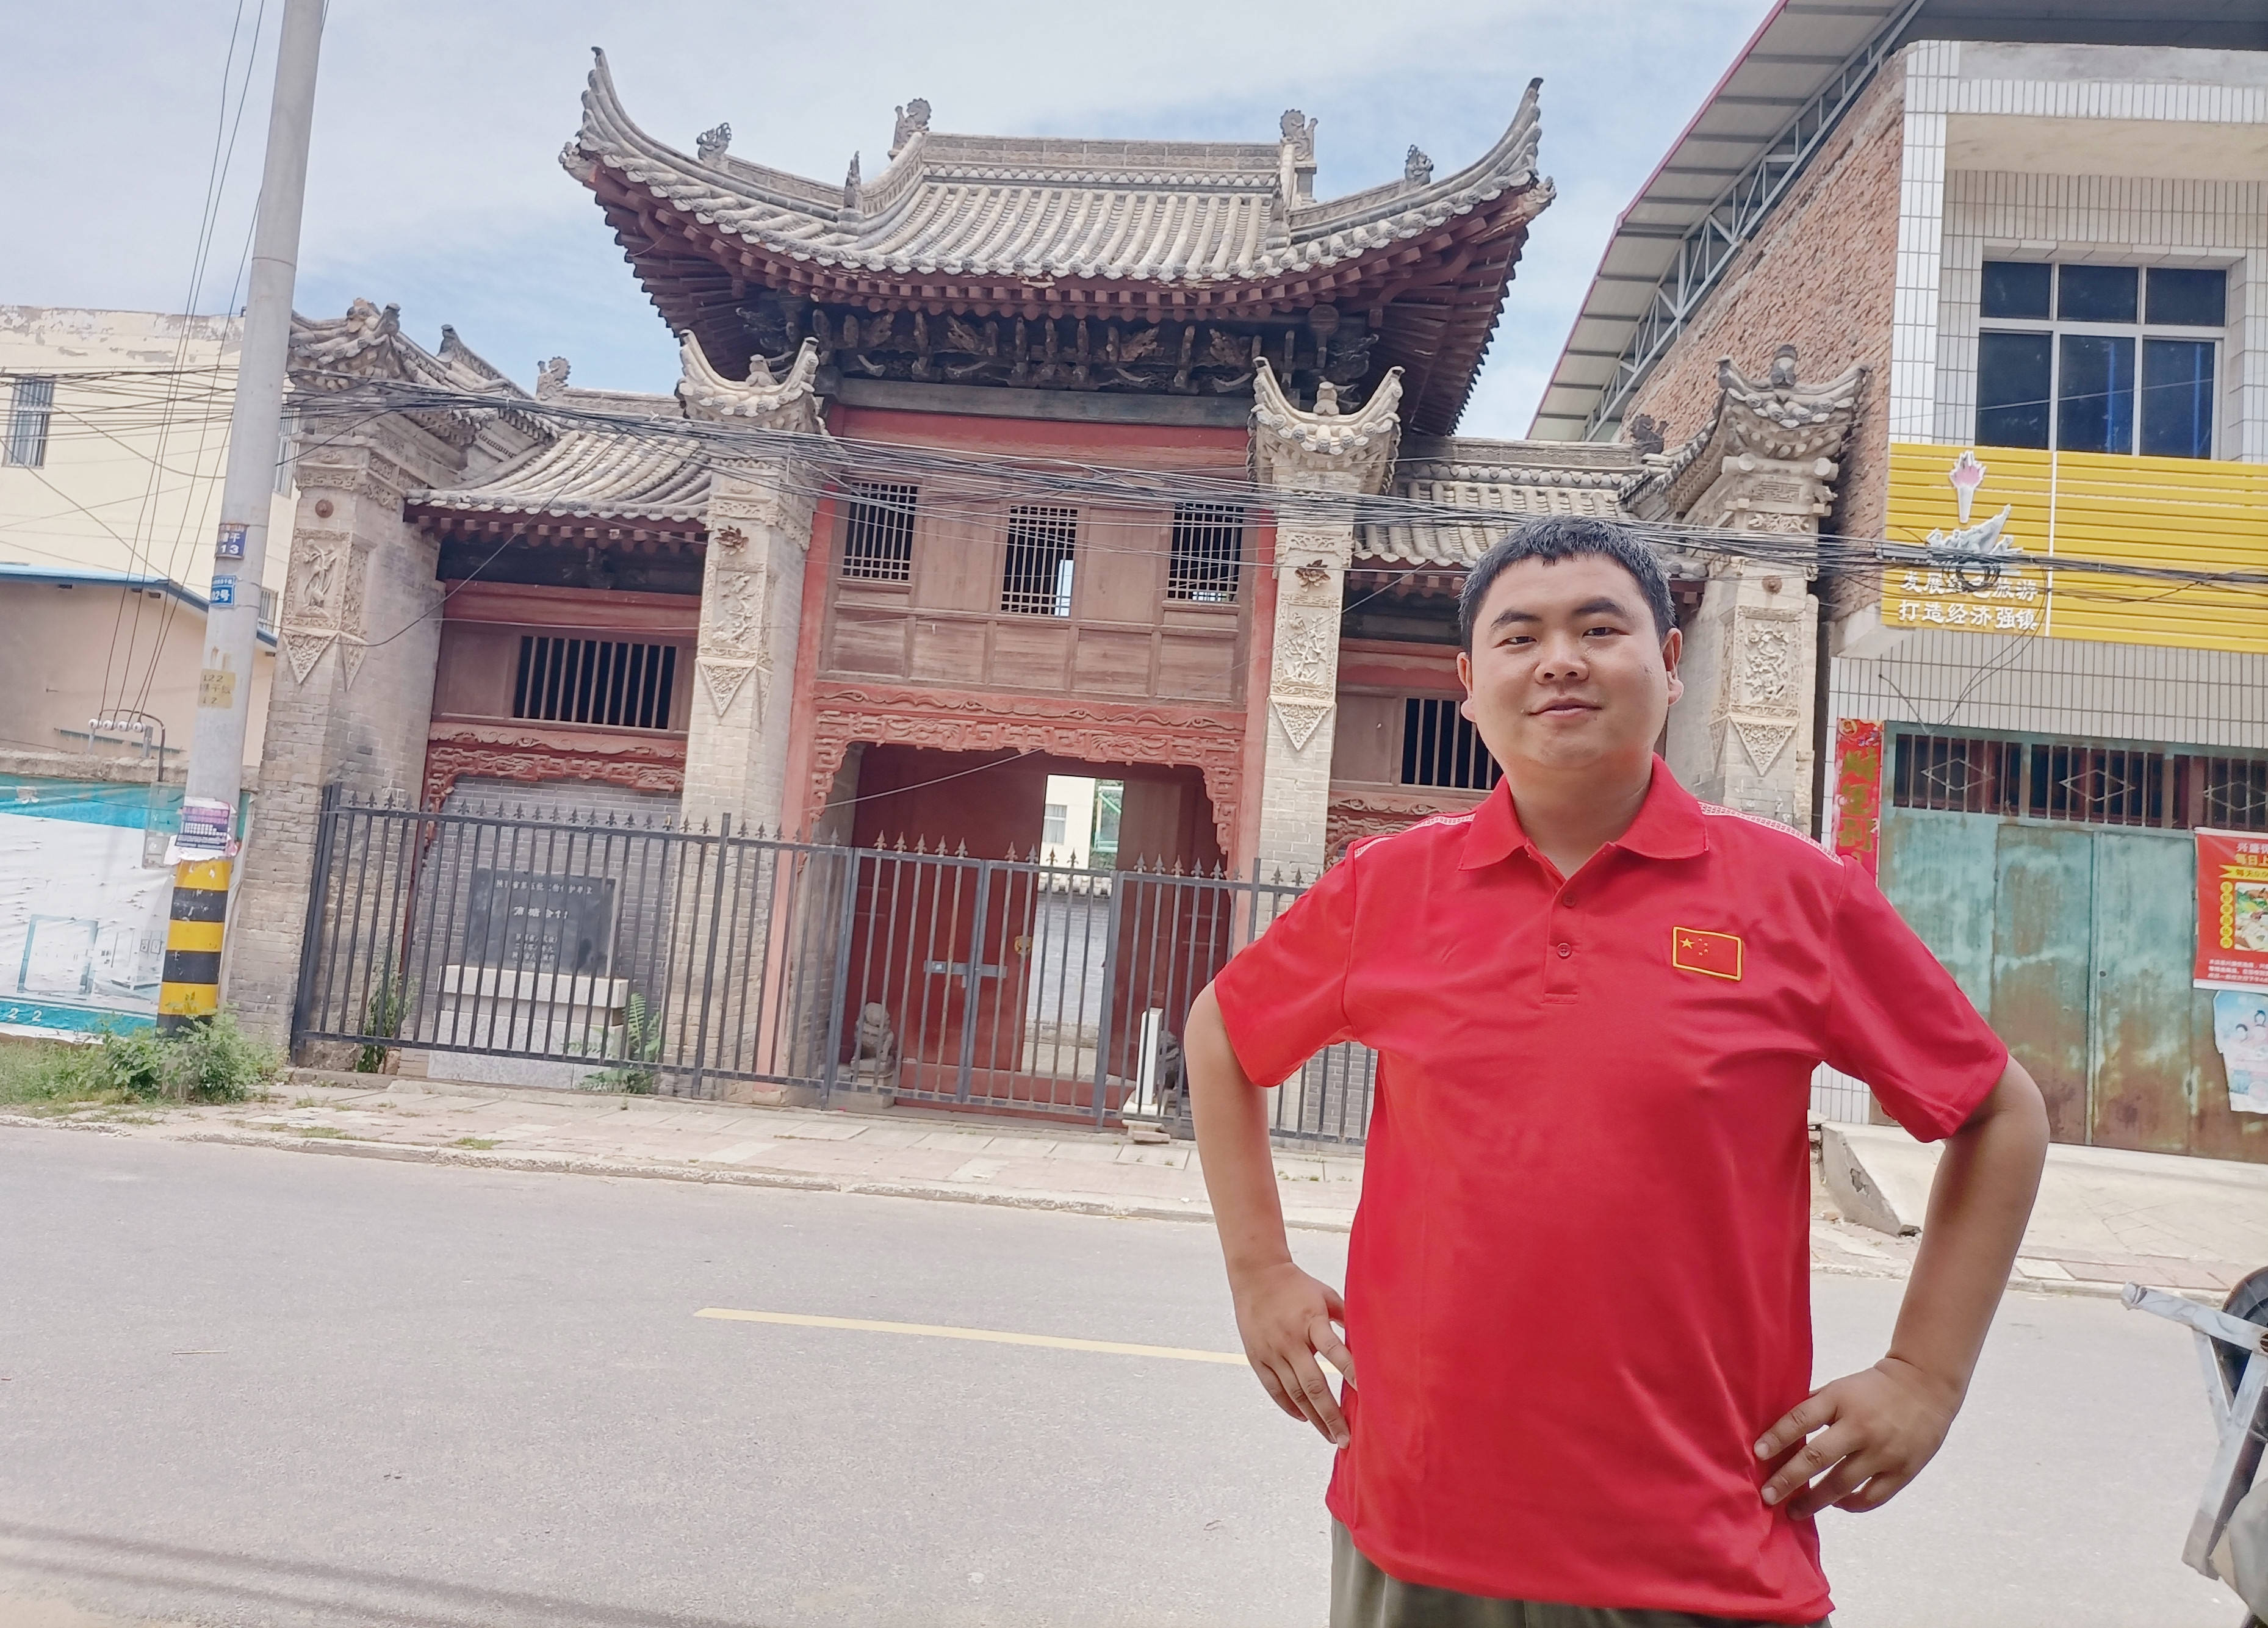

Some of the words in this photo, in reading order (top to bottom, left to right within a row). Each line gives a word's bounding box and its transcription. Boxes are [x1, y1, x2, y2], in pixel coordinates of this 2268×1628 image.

[217, 544, 239, 554] 13
[1899, 599, 2039, 631] 打造经济强镇
